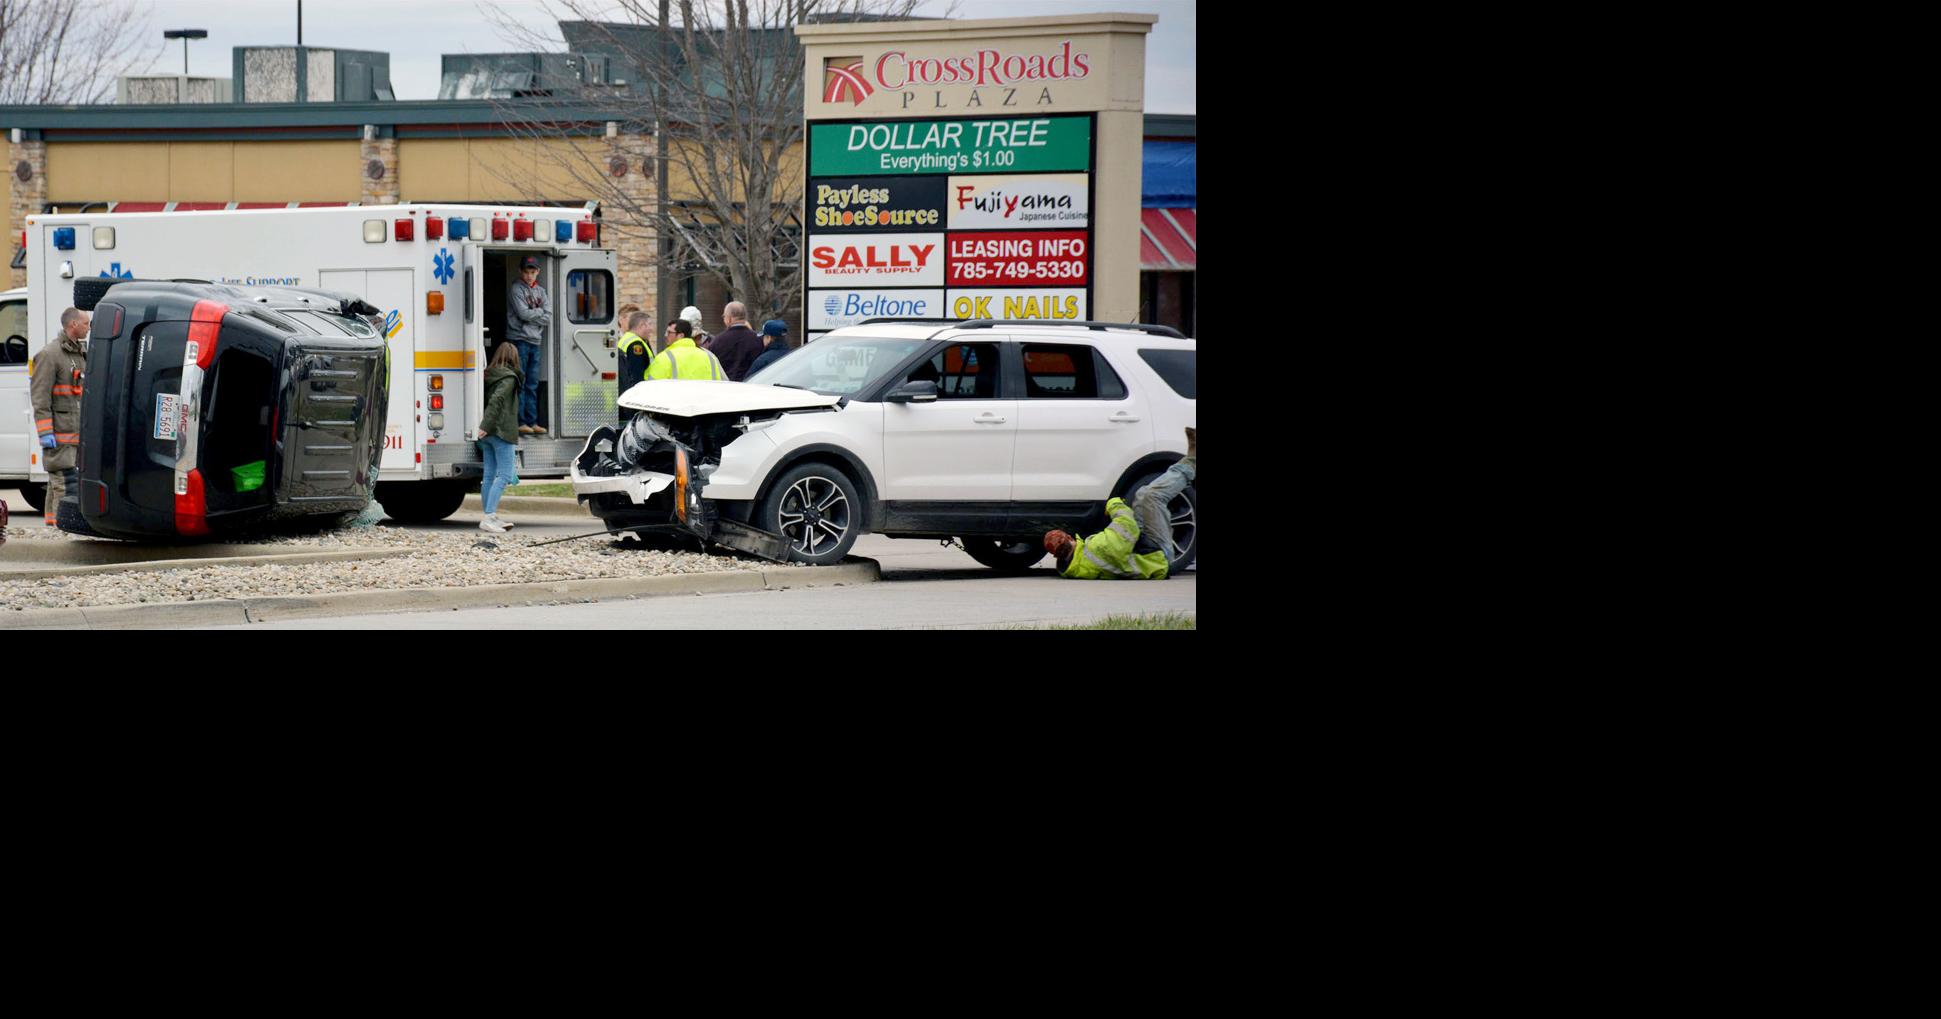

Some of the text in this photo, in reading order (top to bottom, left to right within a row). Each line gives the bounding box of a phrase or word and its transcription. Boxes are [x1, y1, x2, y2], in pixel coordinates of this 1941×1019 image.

[875, 41, 1090, 90] CrossRoads
[902, 87, 1053, 108] PLAZA
[848, 120, 1049, 151] DOLLAR TREE
[880, 151, 1014, 172] Everything's $1.00
[817, 184, 889, 208] Payless
[957, 186, 1072, 218] Fujiyama
[815, 206, 939, 226] ShoeSource
[1019, 211, 1088, 222] Japanese Cuisine
[812, 244, 935, 268] SALLY
[951, 239, 1085, 258] LEASING INFO
[825, 267, 870, 275] BEAUTY
[952, 260, 1084, 279] 785-749-5330
[844, 293, 926, 316] Beltone
[953, 295, 1079, 319] OK NAILS
[625, 401, 670, 411] EXPLORER
[179, 404, 188, 432] GMC
[384, 434, 402, 449] 911
